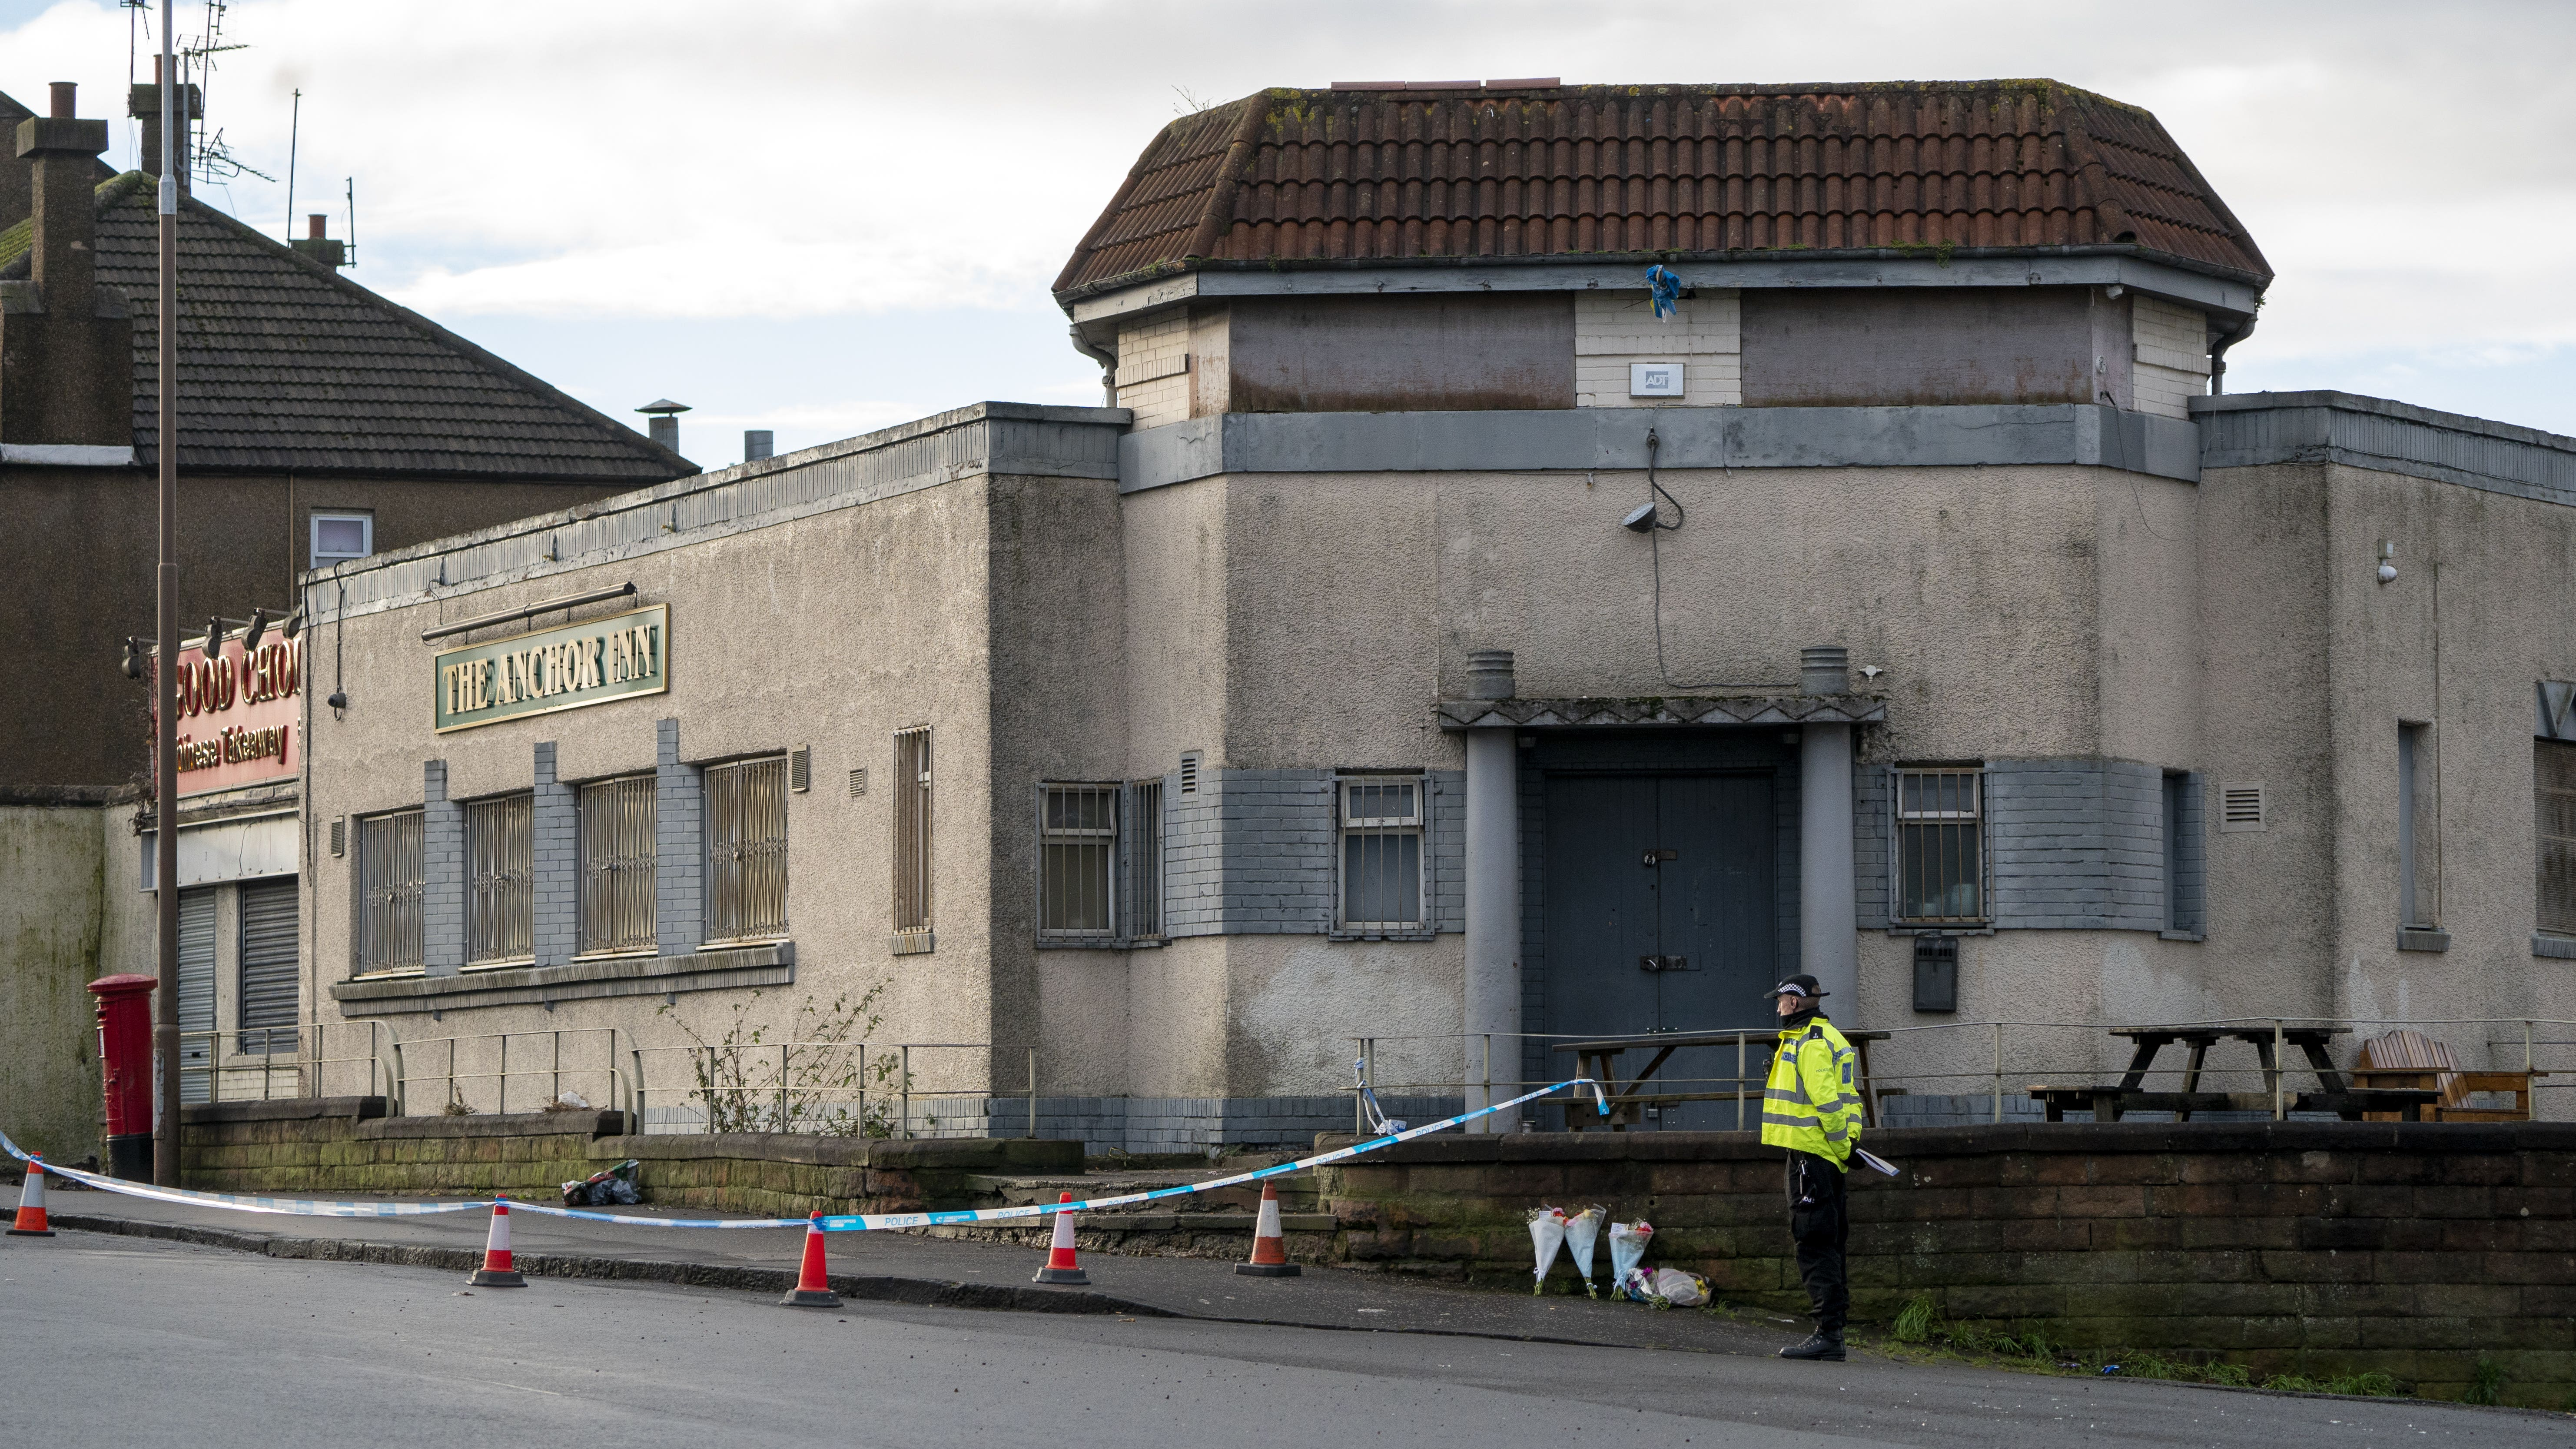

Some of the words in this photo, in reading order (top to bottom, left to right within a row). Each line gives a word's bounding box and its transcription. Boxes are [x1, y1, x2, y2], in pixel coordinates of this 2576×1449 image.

[1646, 375, 1668, 386] ADT
[176, 655, 233, 718] OOD
[443, 658, 488, 715] THE
[494, 636, 598, 706] ANCHOR
[608, 624, 651, 684] INN
[175, 733, 219, 773] hinese
[221, 724, 287, 764] Takeaway
[884, 1216, 919, 1226] POLICE
